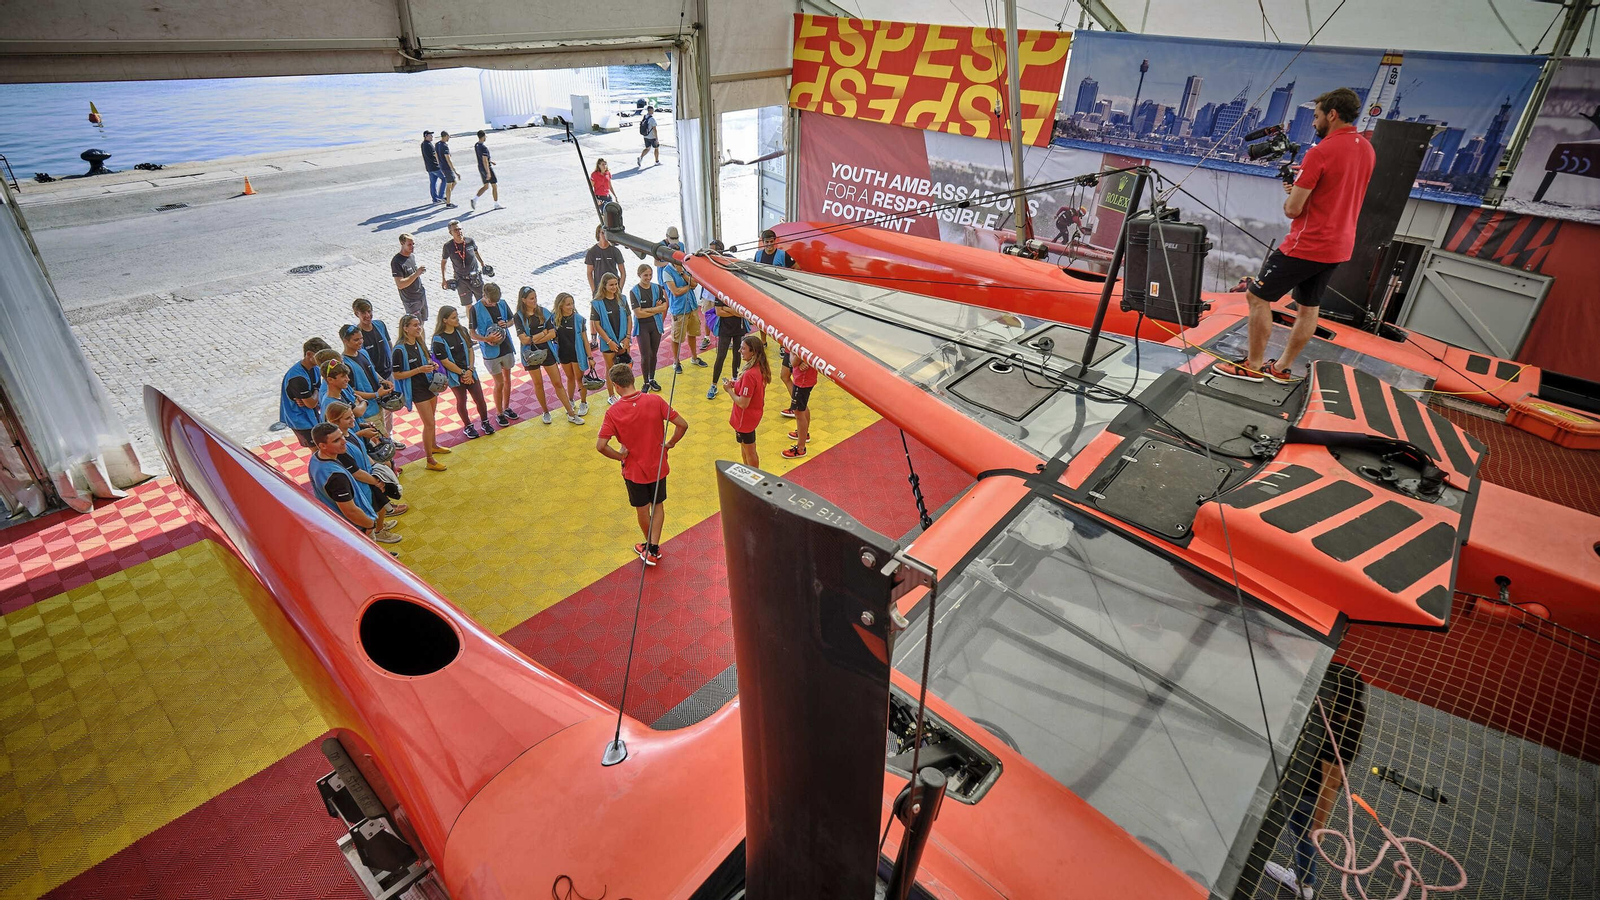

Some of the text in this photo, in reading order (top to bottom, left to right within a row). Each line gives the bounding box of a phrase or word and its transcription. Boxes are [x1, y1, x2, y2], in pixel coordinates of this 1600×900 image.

[1388, 67, 1399, 86] ESP
[831, 162, 889, 188] YOUTH
[825, 181, 999, 231] FOR A RESPONSIBLE
[1105, 192, 1130, 208] ROLEX
[822, 199, 916, 233] FOOTPRINT
[717, 291, 765, 332] POWERED
[766, 324, 784, 341] BY
[733, 465, 752, 475] ESP
[787, 493, 815, 510] LAB
